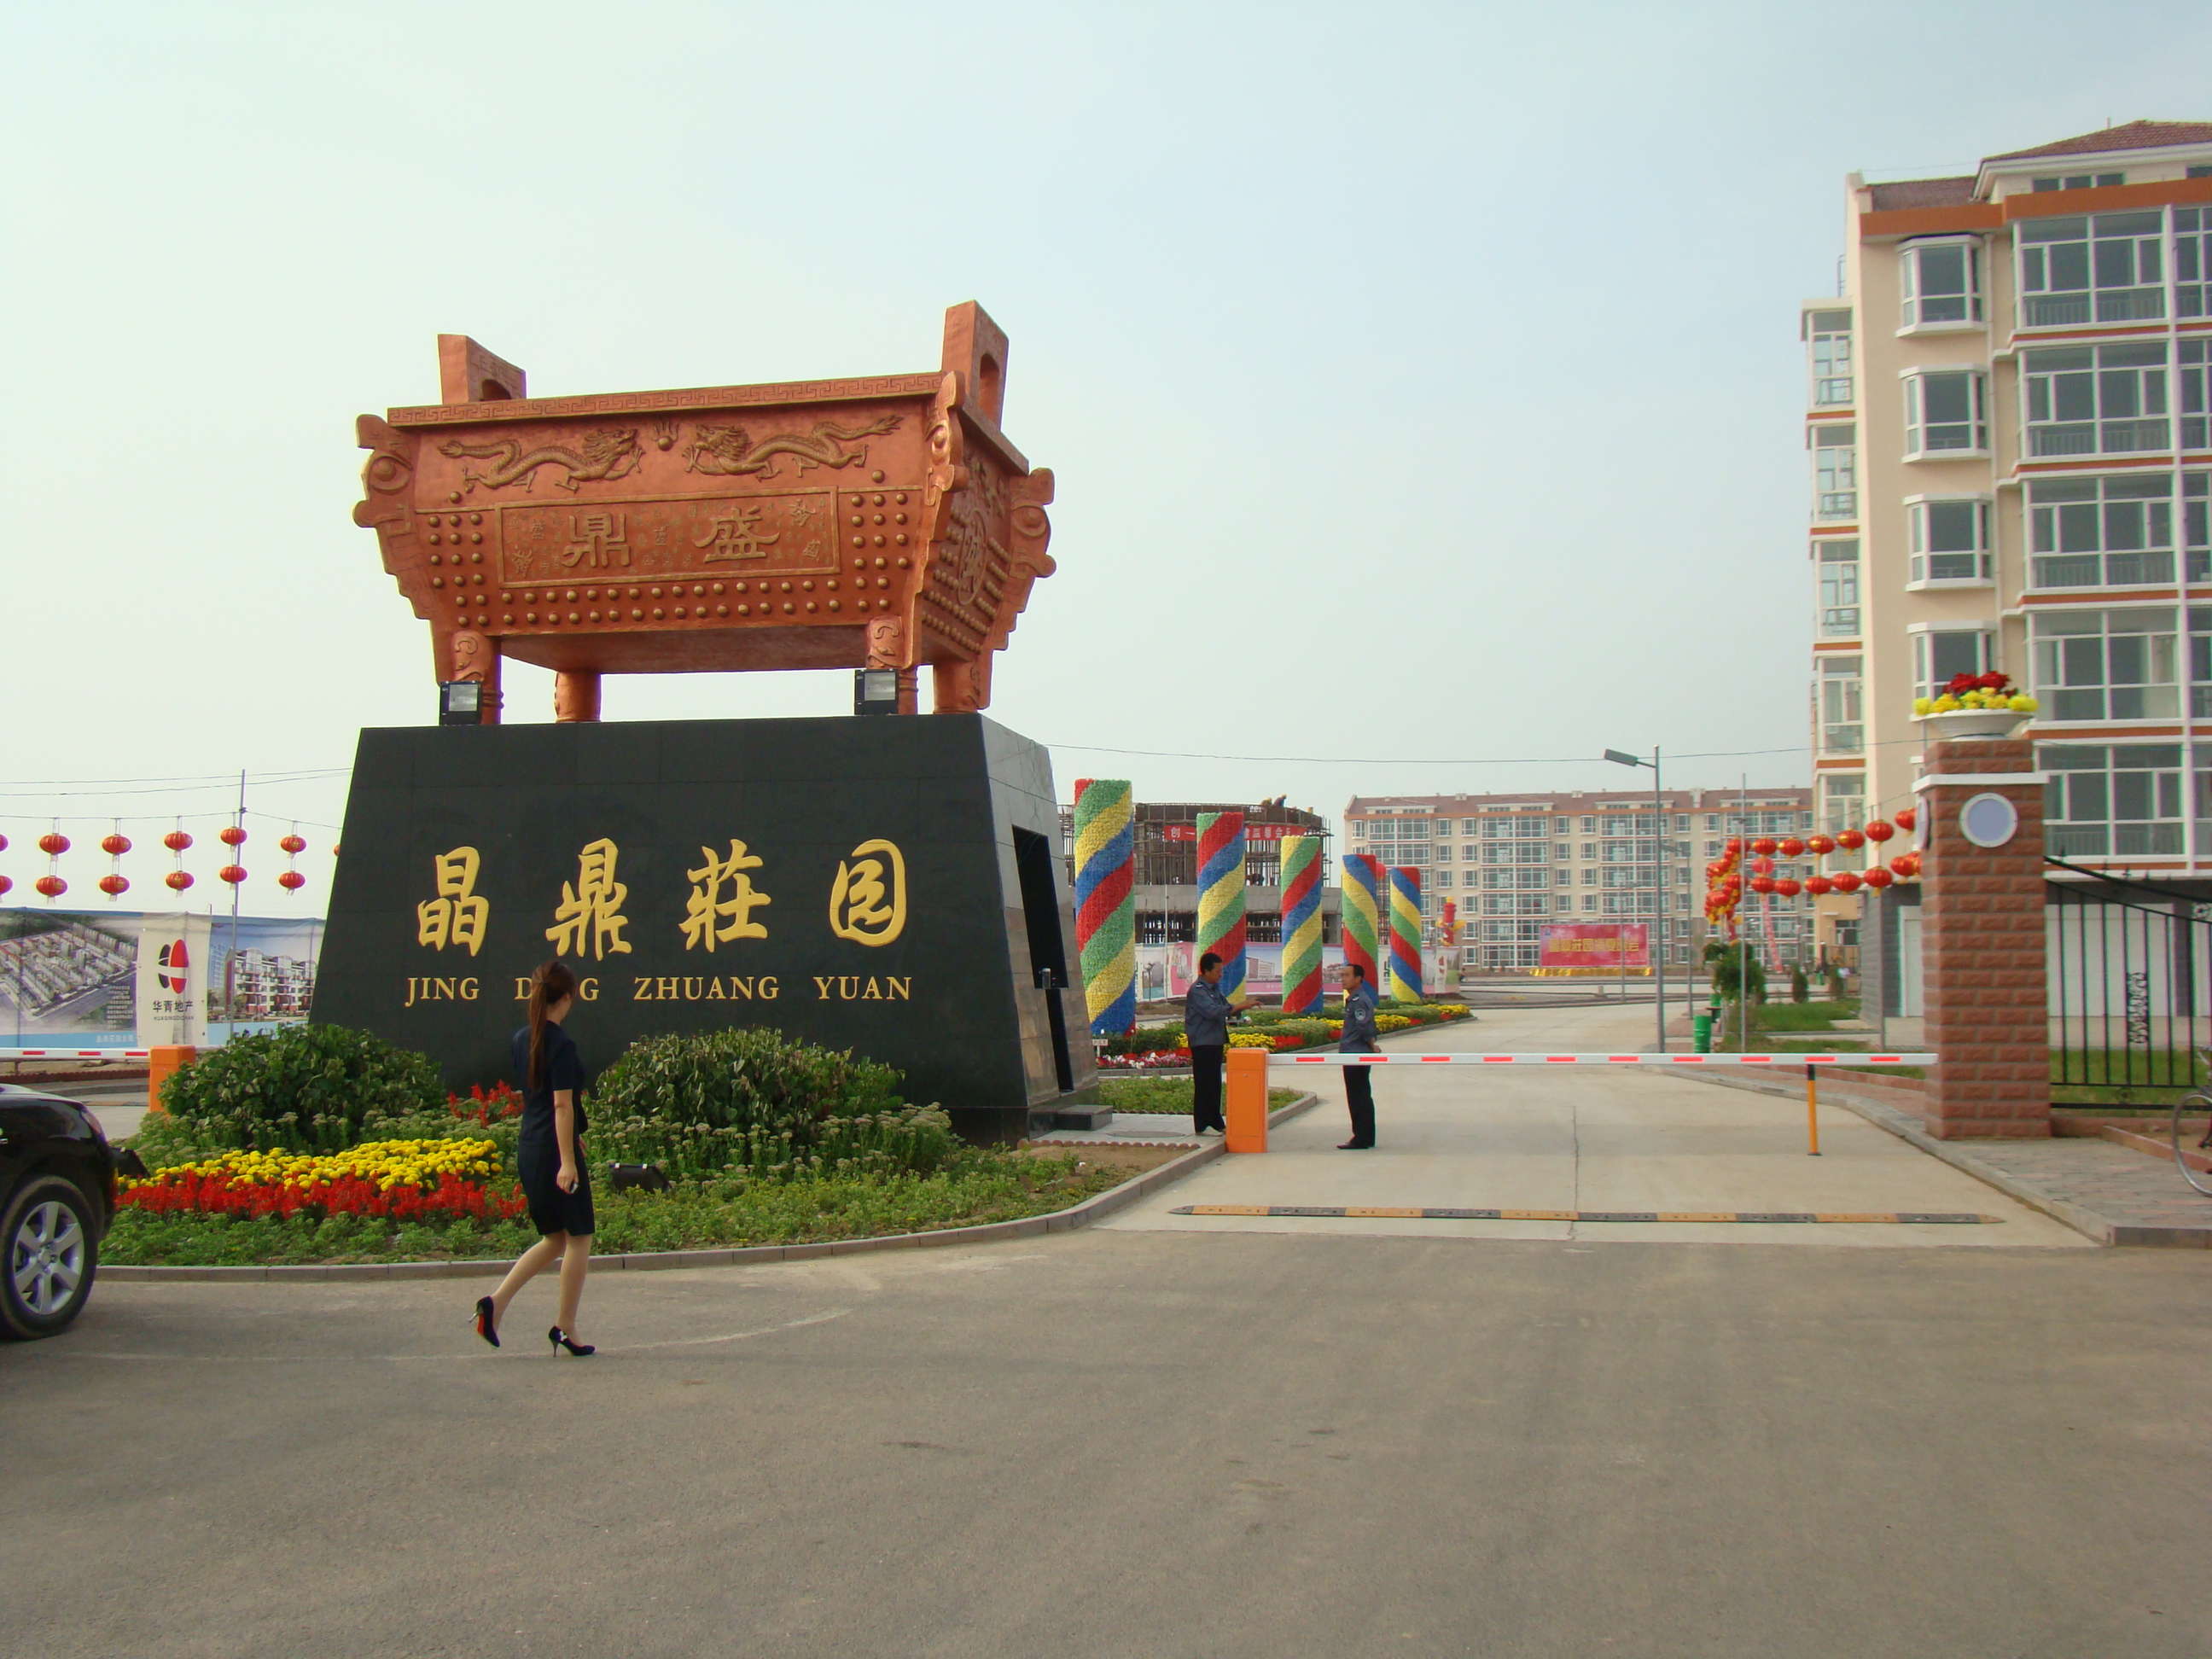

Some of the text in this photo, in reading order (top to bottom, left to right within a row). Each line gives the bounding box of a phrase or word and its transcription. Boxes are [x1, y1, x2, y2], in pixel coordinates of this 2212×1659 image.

[405, 976, 912, 1007] JING DG ZHUANG YUAN
[153, 999, 194, 1013] 华青地产
